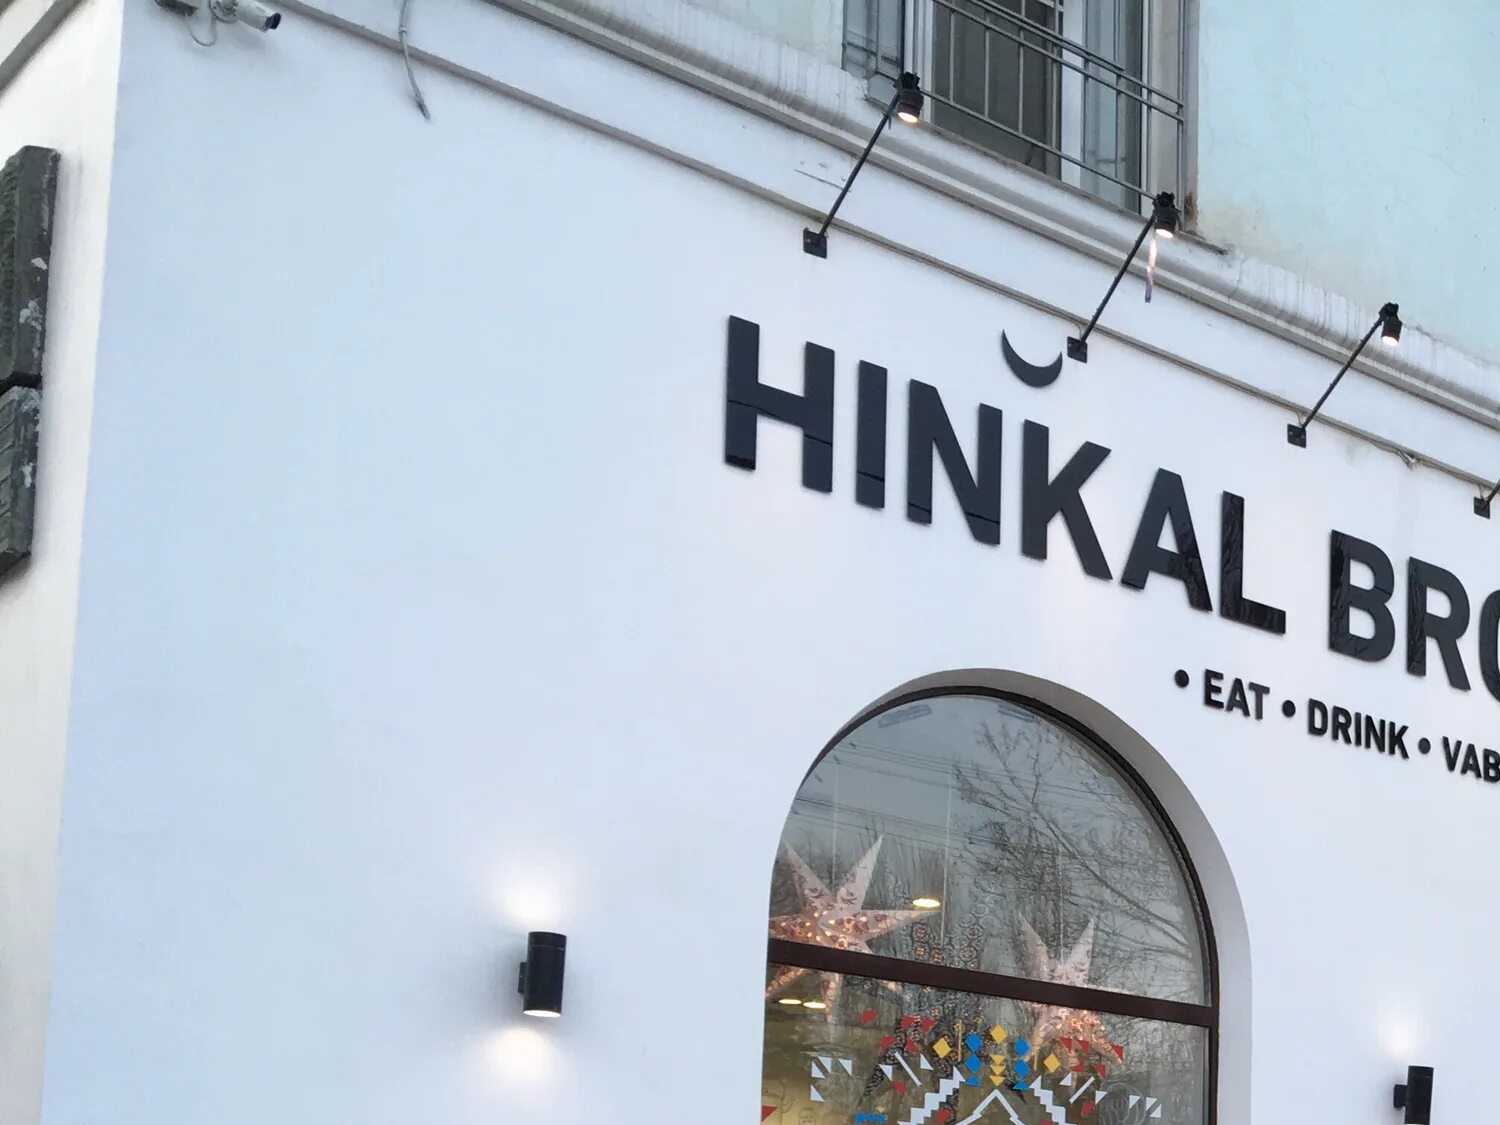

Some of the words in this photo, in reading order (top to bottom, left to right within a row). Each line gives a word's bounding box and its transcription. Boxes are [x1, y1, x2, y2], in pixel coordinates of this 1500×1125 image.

[724, 314, 1287, 635] HINKAL
[1203, 669, 1271, 721] EAT
[1307, 698, 1409, 760] DRINK
